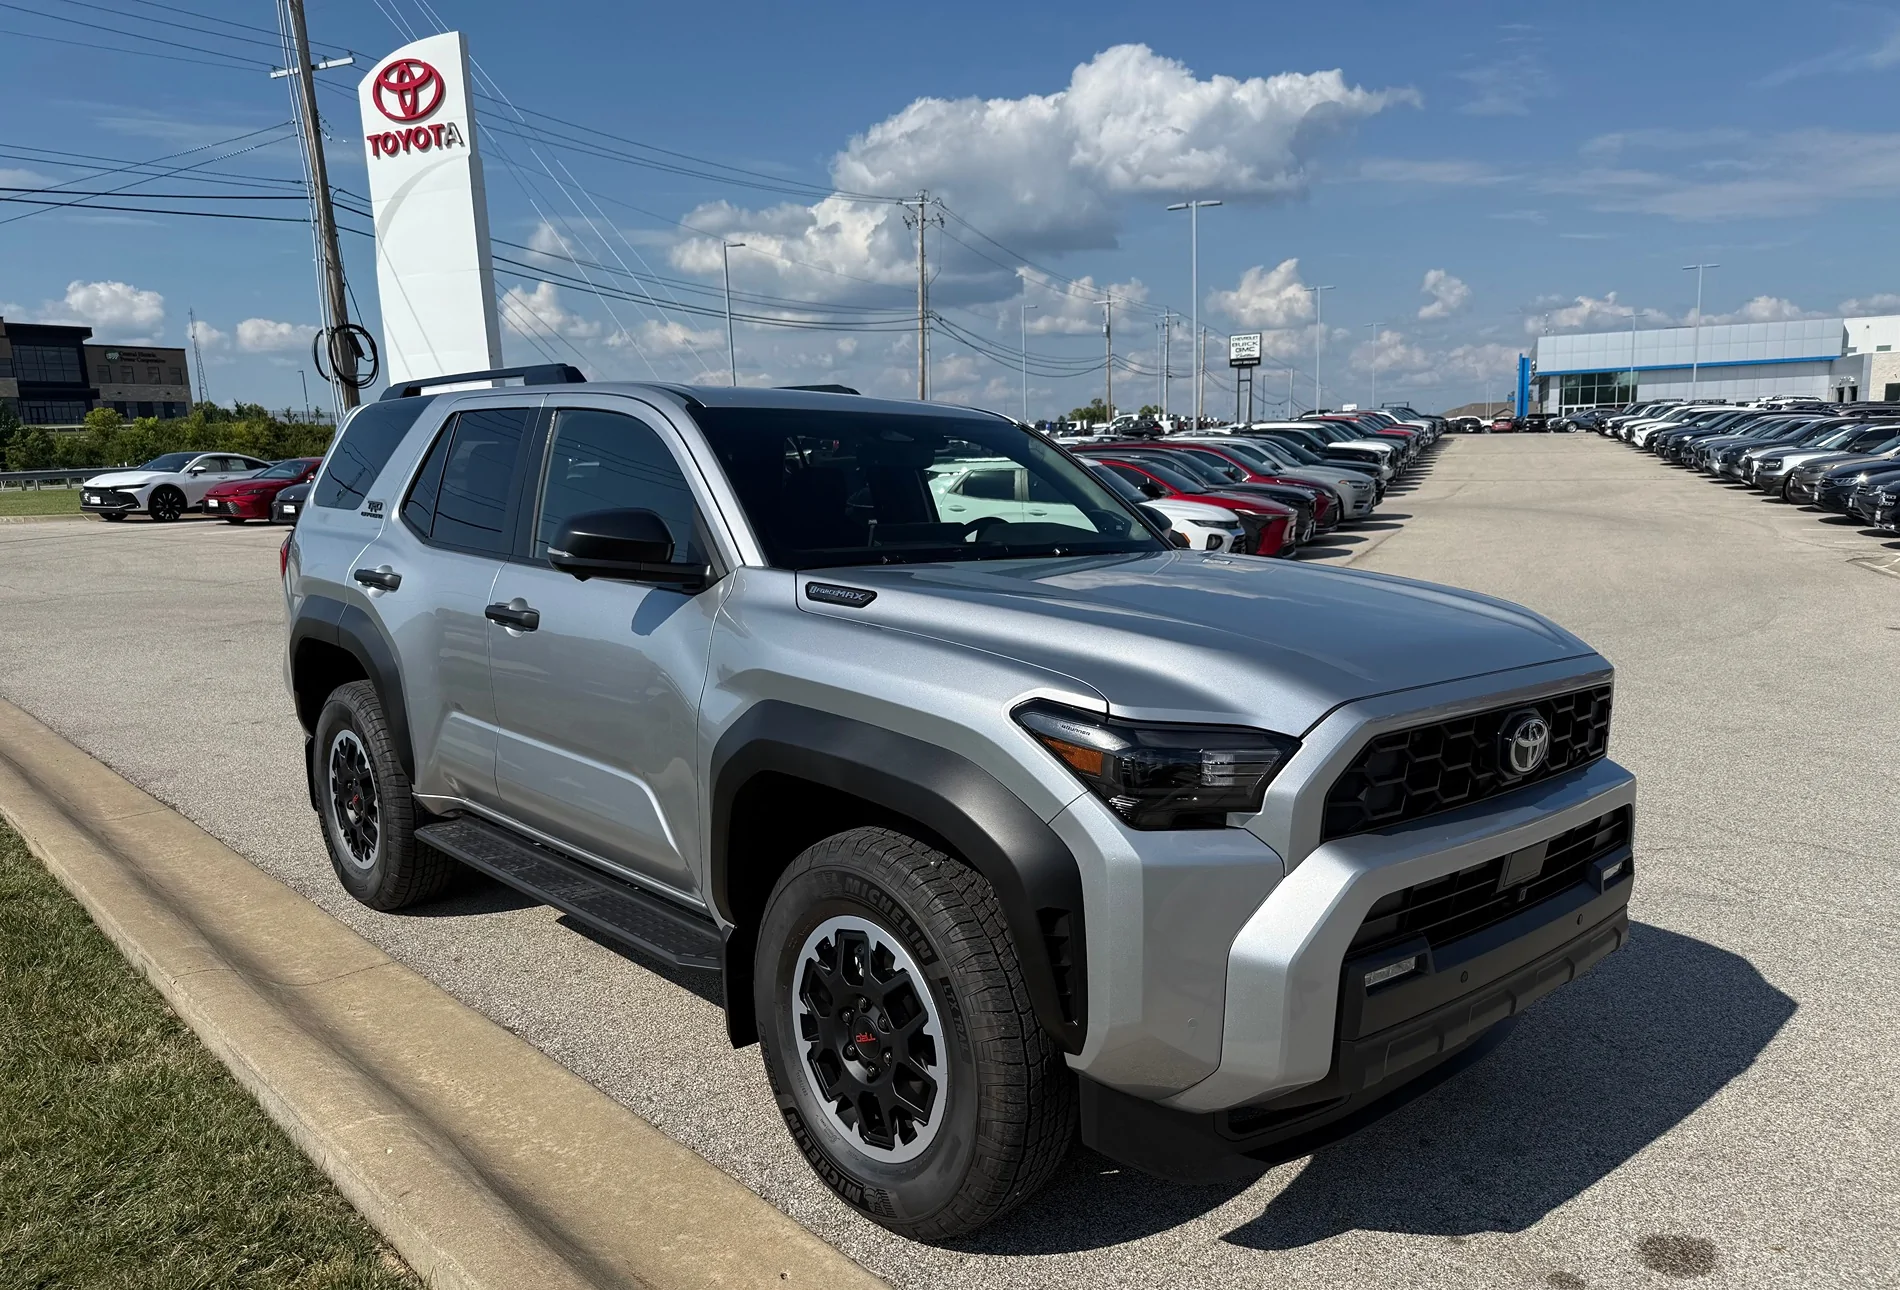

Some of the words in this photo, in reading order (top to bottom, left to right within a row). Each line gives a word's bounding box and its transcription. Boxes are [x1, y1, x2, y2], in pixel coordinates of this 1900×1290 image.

[367, 122, 465, 158] TOYOTA
[844, 876, 934, 963] MICHELIN
[942, 983, 959, 1012] LTX
[855, 1032, 876, 1043] TRD
[786, 1112, 864, 1204] MICHELIN
